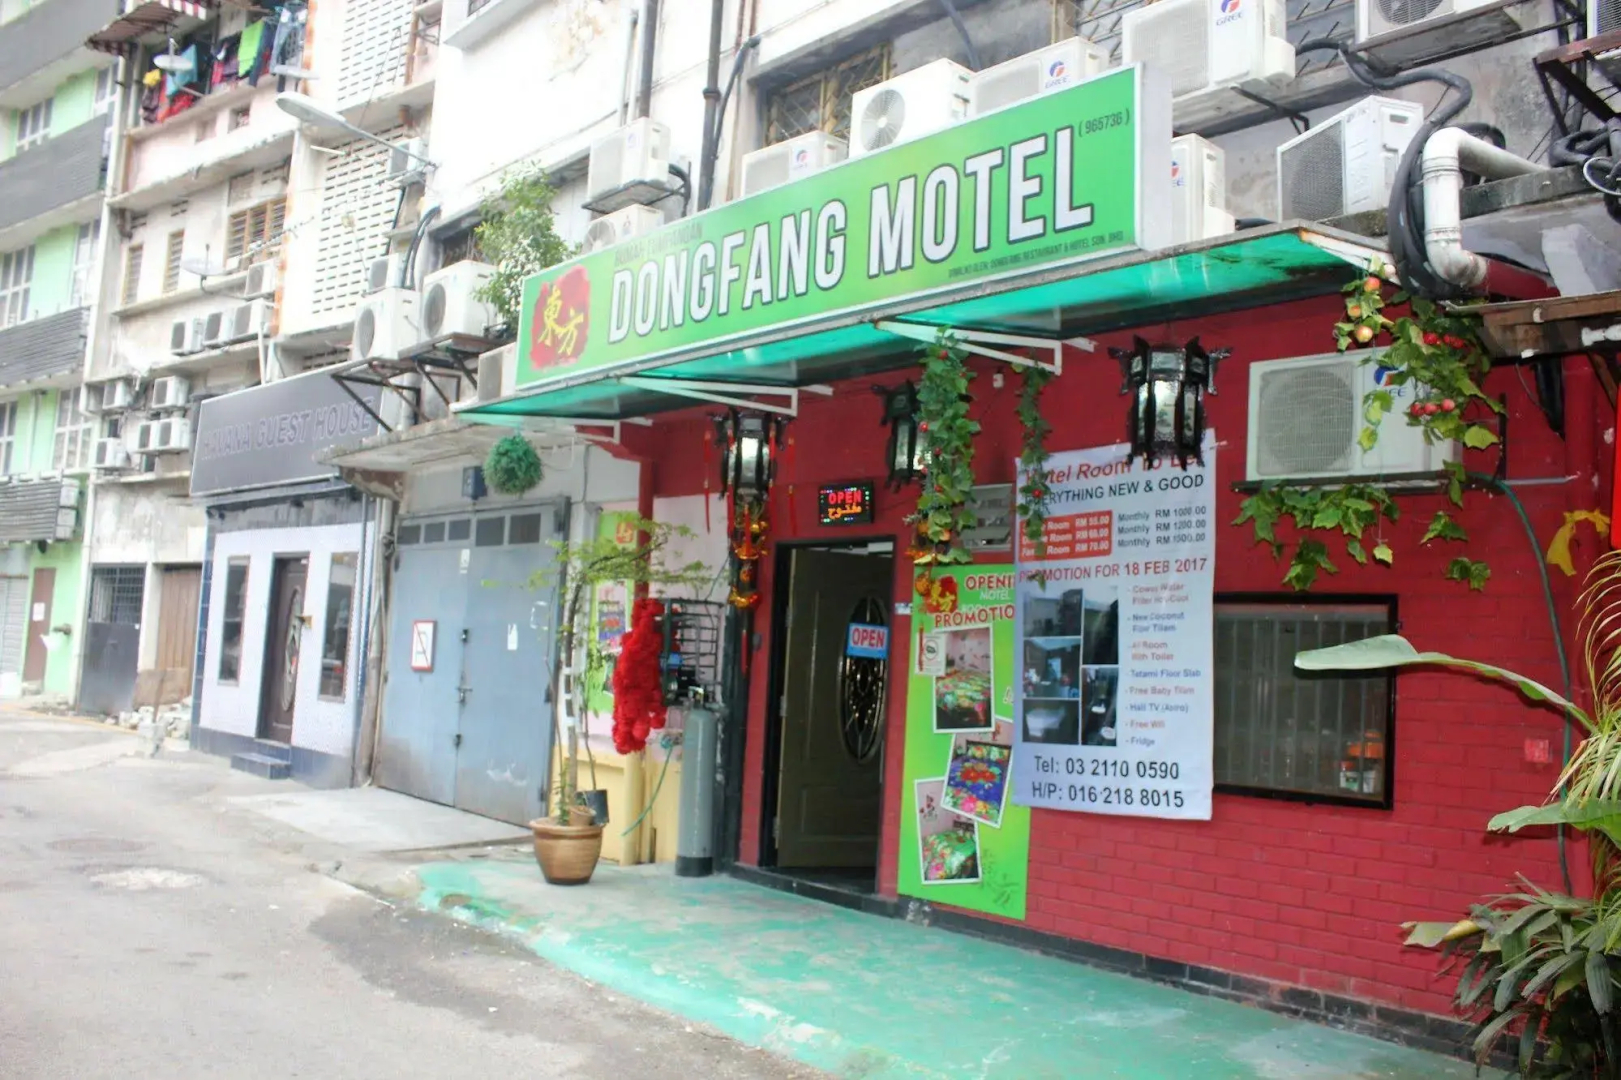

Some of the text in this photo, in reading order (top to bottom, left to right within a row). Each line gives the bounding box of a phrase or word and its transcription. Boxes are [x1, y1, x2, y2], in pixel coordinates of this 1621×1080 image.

[607, 125, 1095, 344] DONGFANG MOTEL
[538, 284, 584, 356] 東方
[255, 410, 312, 449] GUEST
[313, 396, 376, 441] HOUSE
[1077, 458, 1131, 480] Room
[1108, 481, 1139, 498] NEW
[1143, 479, 1153, 493] &
[1158, 474, 1204, 492] GOOD
[828, 491, 862, 504] OPEN
[827, 504, 862, 520] مفتوح
[1118, 505, 1206, 522] Monthly RM 1000.00
[1047, 521, 1070, 530] Room
[1075, 517, 1087, 526] RM
[1118, 519, 1206, 535] Monthly RM 1200.00
[1050, 533, 1072, 542] Room
[1075, 530, 1088, 539] RM
[1118, 537, 1150, 548] Monthly
[1156, 535, 1171, 545] RM
[1047, 545, 1070, 555] Room
[1075, 543, 1088, 552] RM
[1095, 564, 1120, 578] FOR
[1124, 562, 1140, 576] 18
[1144, 560, 1170, 575] FEB
[1175, 557, 1207, 573] 2017
[852, 627, 885, 648] OPEN
[1160, 668, 1181, 677] Floor
[1183, 668, 1201, 677] Slab
[1129, 686, 1148, 695] Free
[1150, 686, 1171, 696] Baby
[1148, 703, 1160, 711] TV
[1130, 720, 1149, 728] Free
[1130, 736, 1155, 747] Fridge
[1034, 755, 1179, 780] Tel: 03 2110 0590
[1032, 781, 1184, 808] H/P: 016 218 8015
